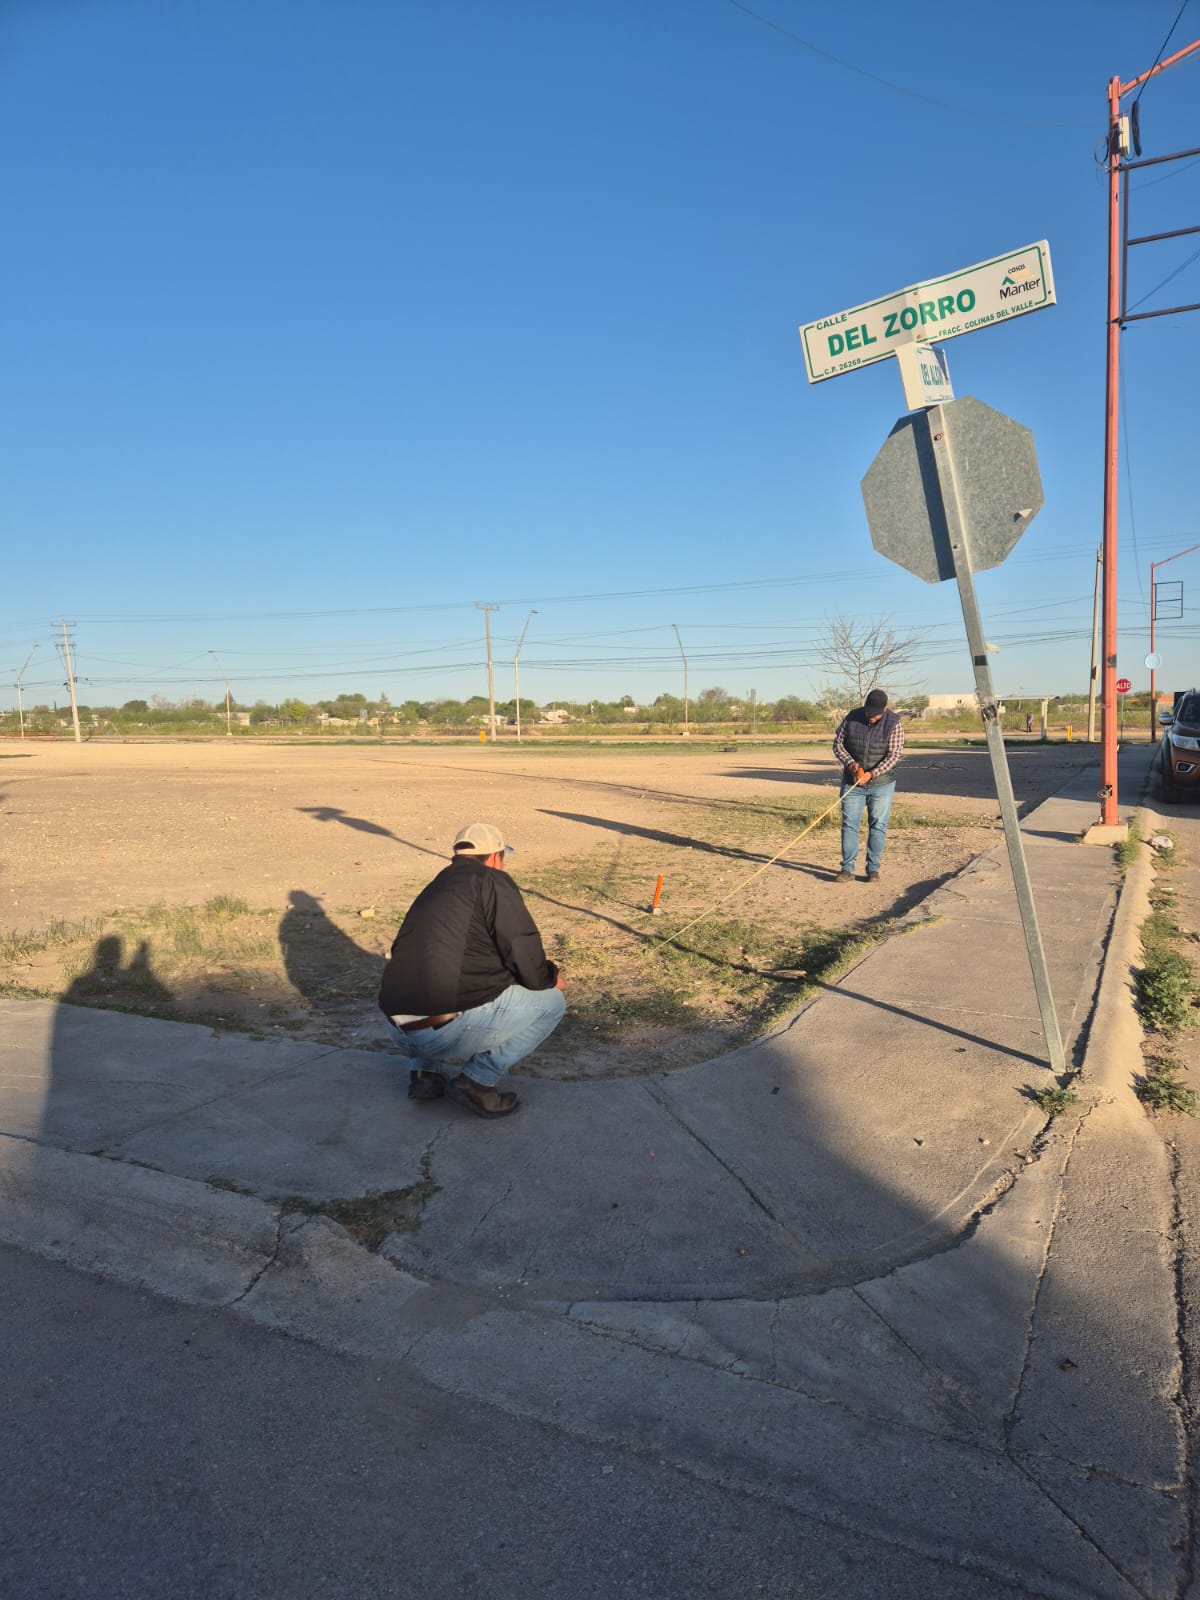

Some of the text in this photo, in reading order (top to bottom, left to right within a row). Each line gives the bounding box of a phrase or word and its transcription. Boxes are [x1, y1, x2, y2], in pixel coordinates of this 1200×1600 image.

[1008, 263, 1025, 274] casas
[999, 277, 1040, 300] Manter
[816, 314, 847, 330] CALLE
[827, 288, 976, 357] DEL ZORRO
[964, 314, 995, 329] COLINAS
[996, 309, 1009, 319] DEL
[1011, 300, 1033, 313] VALLE
[1116, 682, 1131, 690] ALTO
